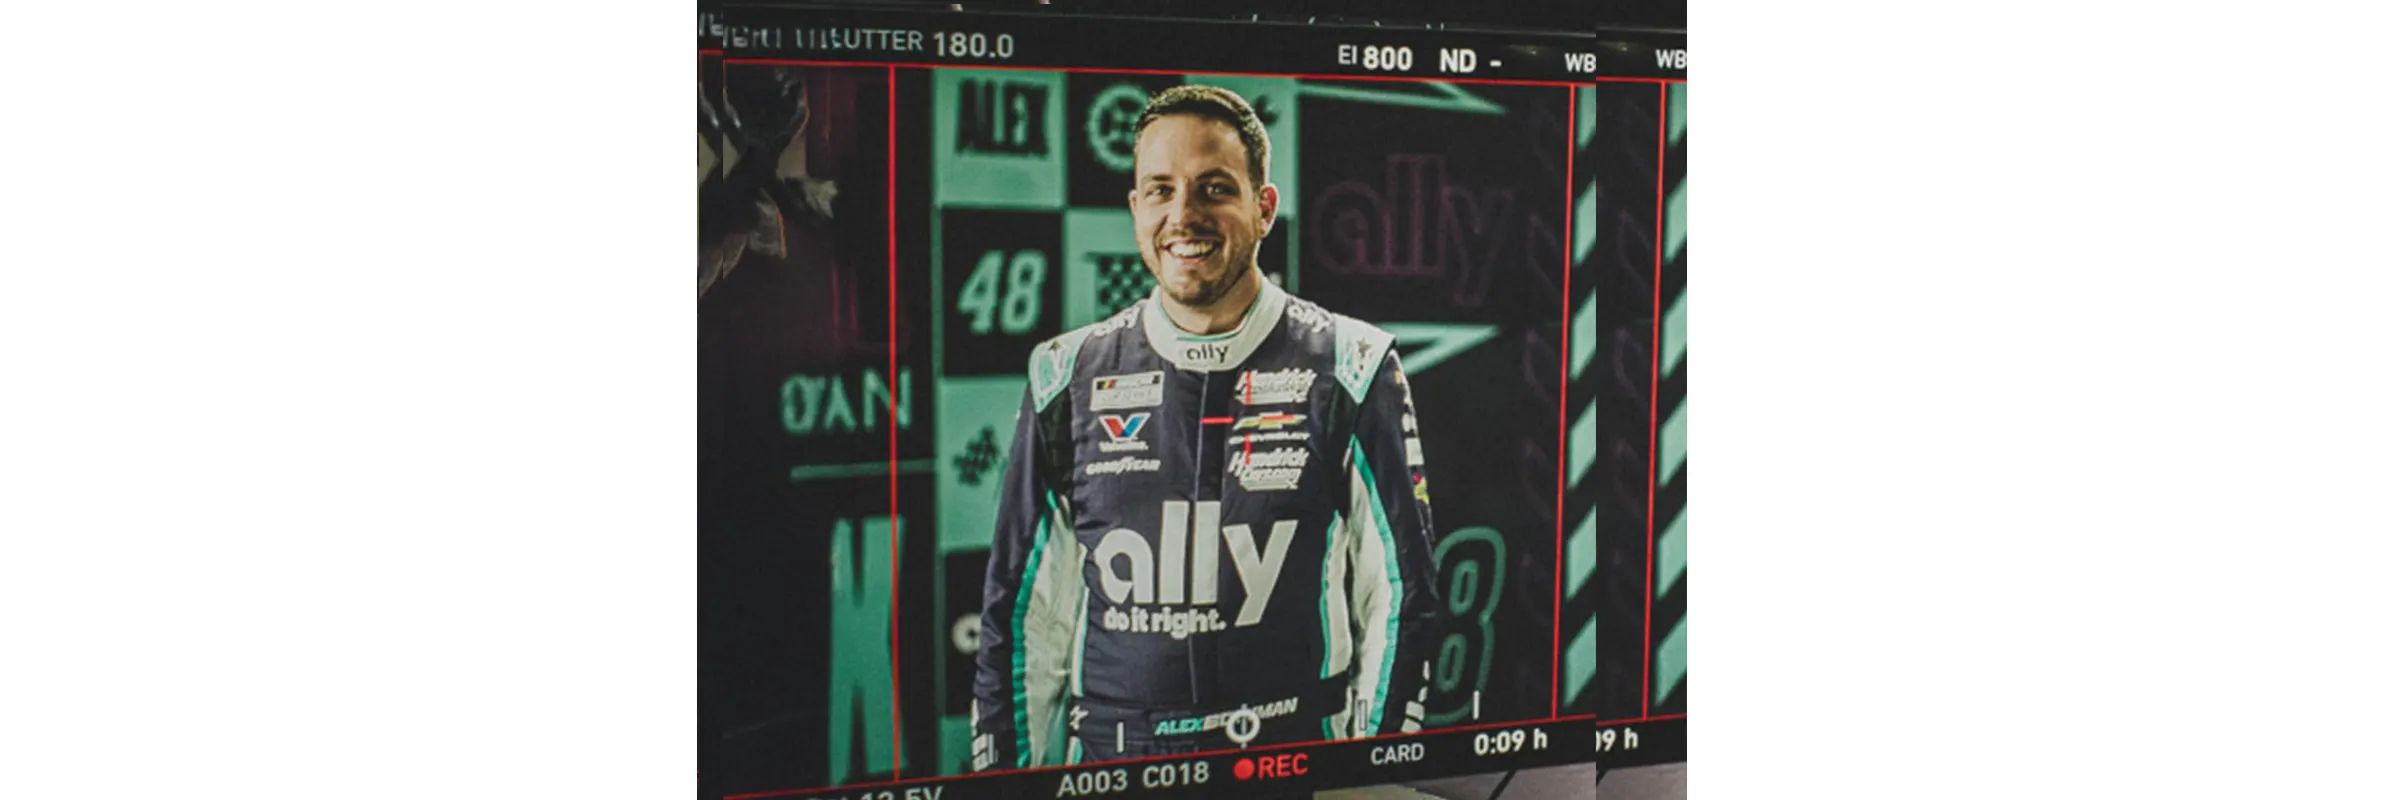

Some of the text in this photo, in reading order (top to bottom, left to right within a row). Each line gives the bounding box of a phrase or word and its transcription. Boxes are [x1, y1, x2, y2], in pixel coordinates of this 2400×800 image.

[932, 32, 1014, 58] 180.0
[1338, 45, 1413, 71] EI 800
[1439, 48, 1477, 73] ND
[1564, 53, 1596, 73] WB
[1655, 49, 1687, 69] WB
[958, 249, 1046, 334] 48
[1186, 342, 1230, 363] ally
[1094, 500, 1300, 626] ally
[1130, 606, 1149, 632] it
[1151, 606, 1227, 640] right.
[1474, 727, 1548, 756] 0:09 h
[1624, 727, 1639, 750] h
[1258, 754, 1309, 779] REC
[1371, 743, 1424, 765] CARD
[1056, 761, 1210, 798] A003 C018
